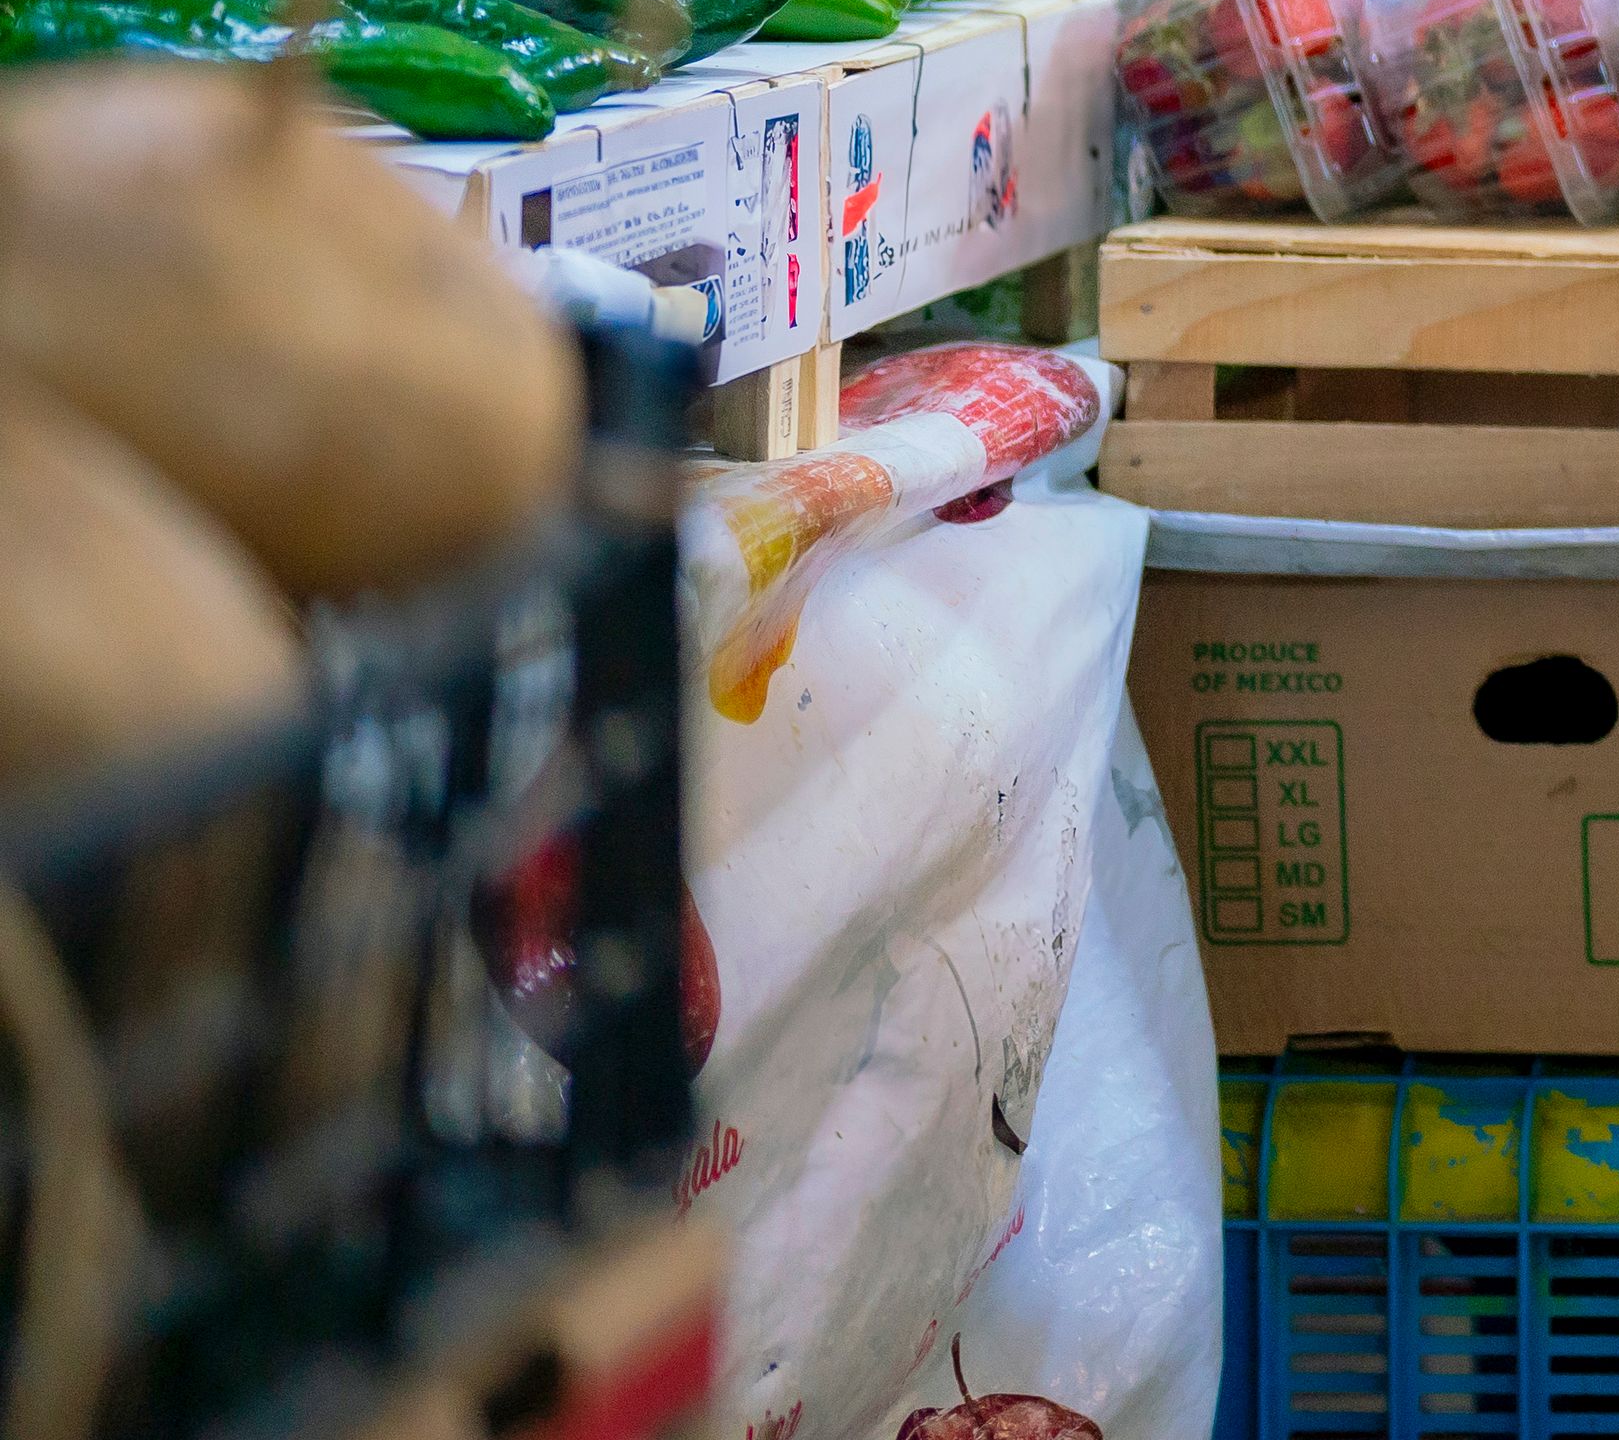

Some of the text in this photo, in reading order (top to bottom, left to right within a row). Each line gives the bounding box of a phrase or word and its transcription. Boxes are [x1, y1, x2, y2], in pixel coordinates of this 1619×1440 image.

[1193, 642, 1319, 664] PRODUCE
[1191, 671, 1344, 694] OF MEXICO
[1267, 739, 1327, 767] XXL
[1279, 781, 1320, 807] XL
[1278, 821, 1322, 849] LG
[1276, 860, 1326, 888] MD
[1279, 902, 1326, 928] SM
